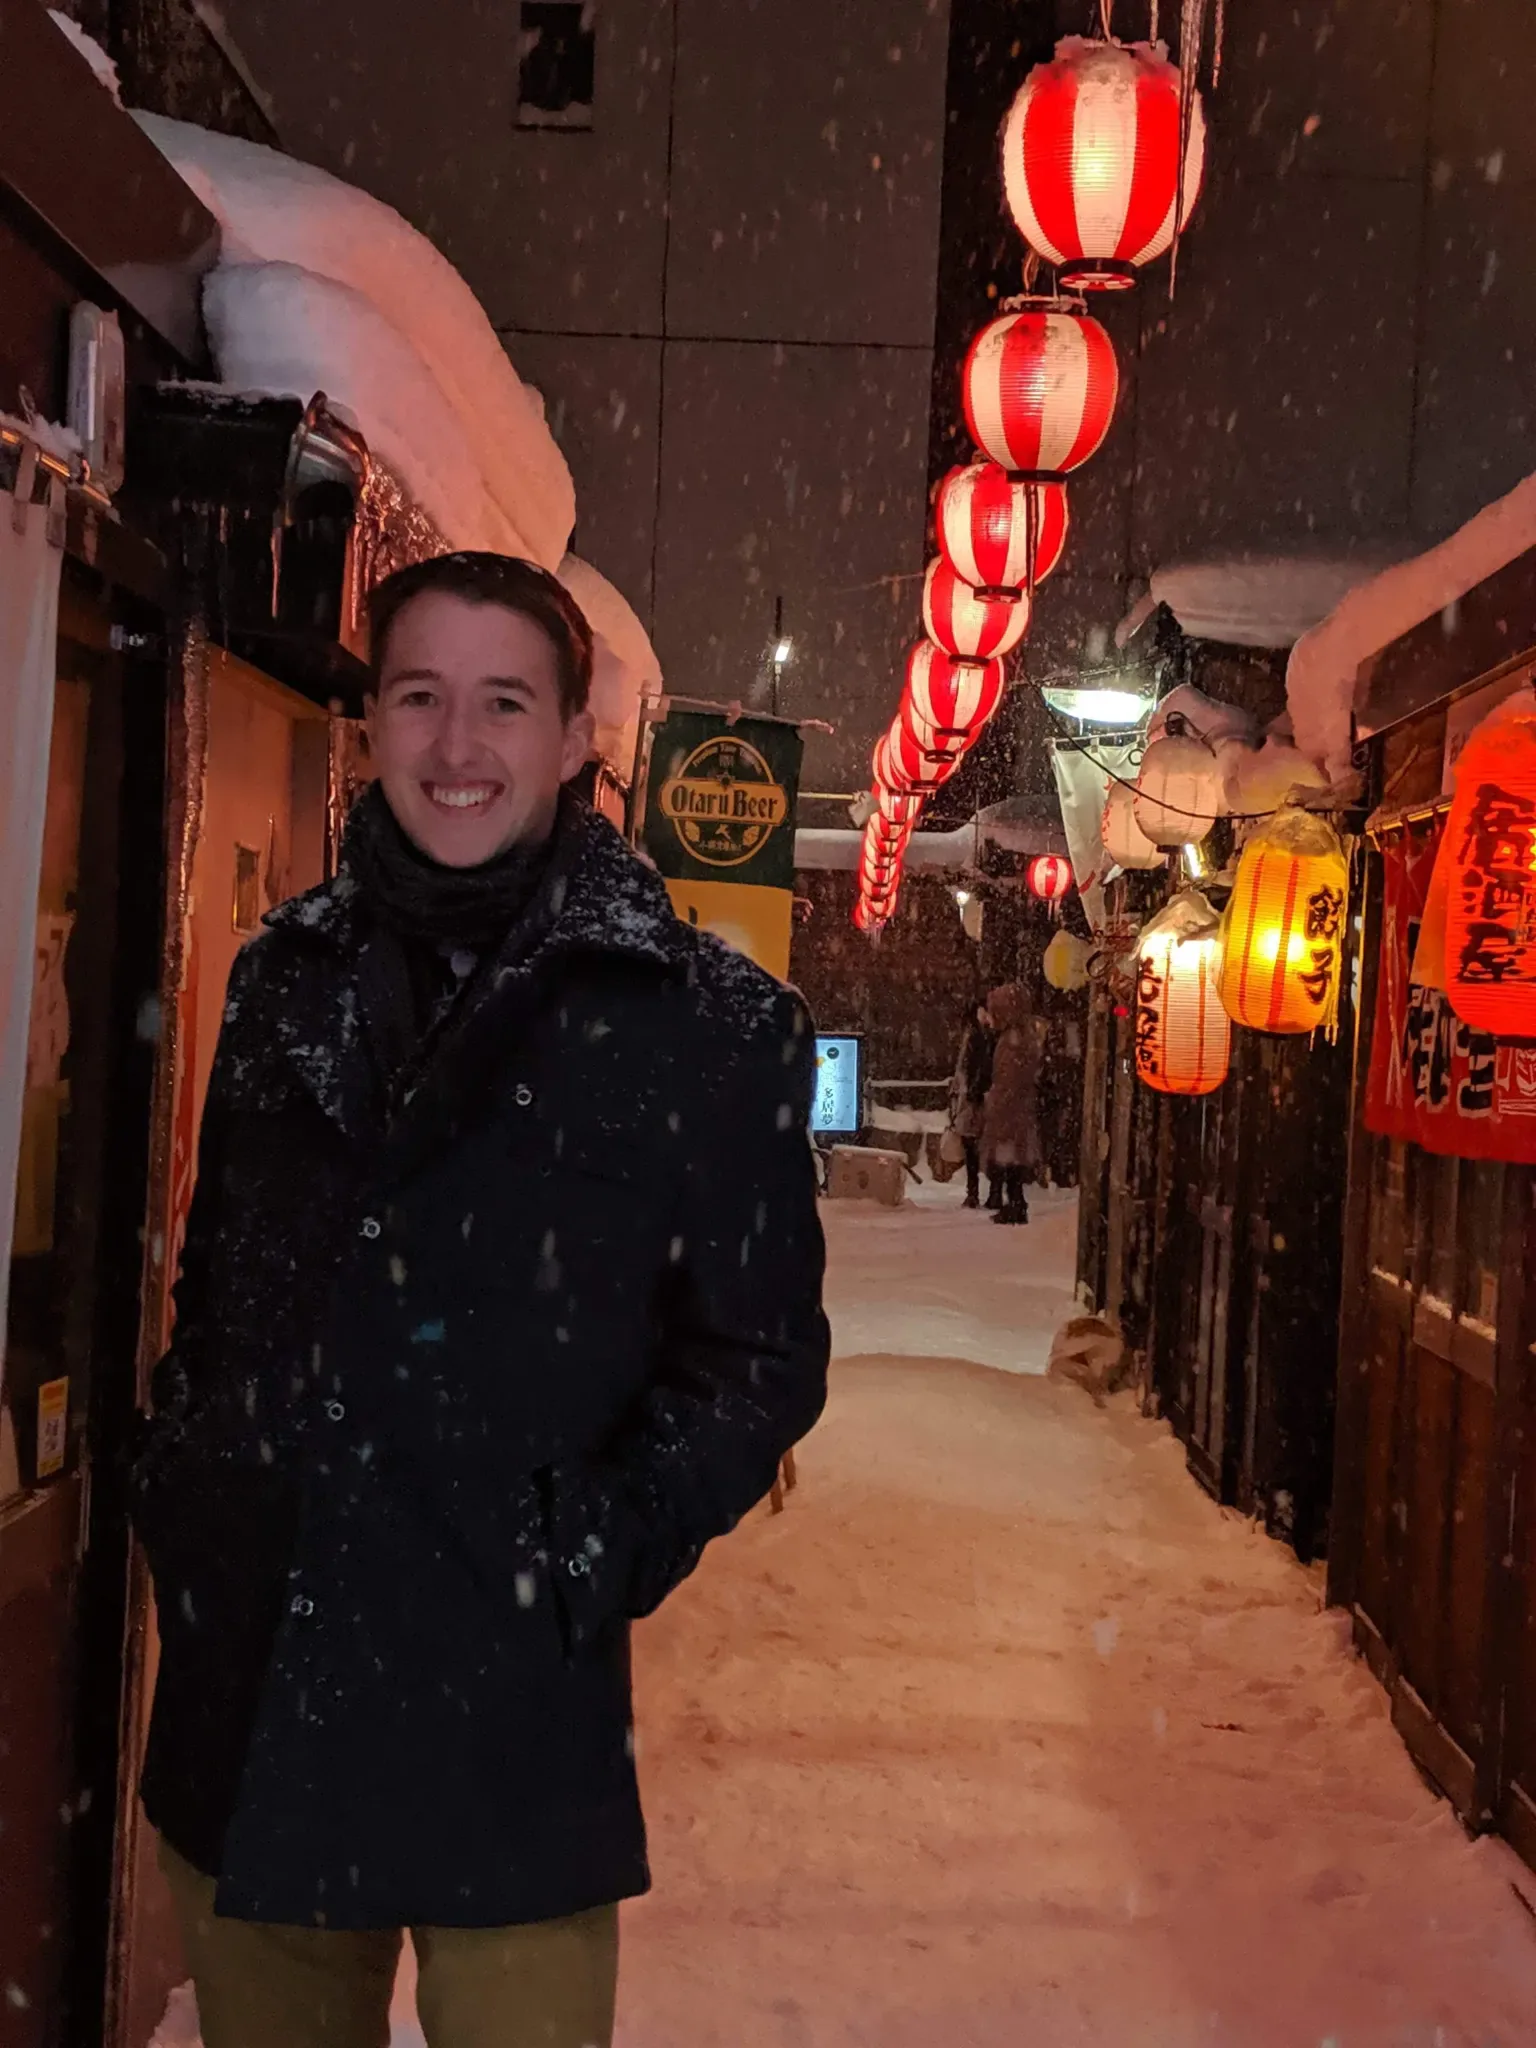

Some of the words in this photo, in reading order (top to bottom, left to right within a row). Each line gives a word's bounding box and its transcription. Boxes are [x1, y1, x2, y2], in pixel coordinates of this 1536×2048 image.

[671, 785, 729, 815] Otaru
[733, 789, 778, 819] Beer
[1457, 783, 1536, 984] 居酒屋
